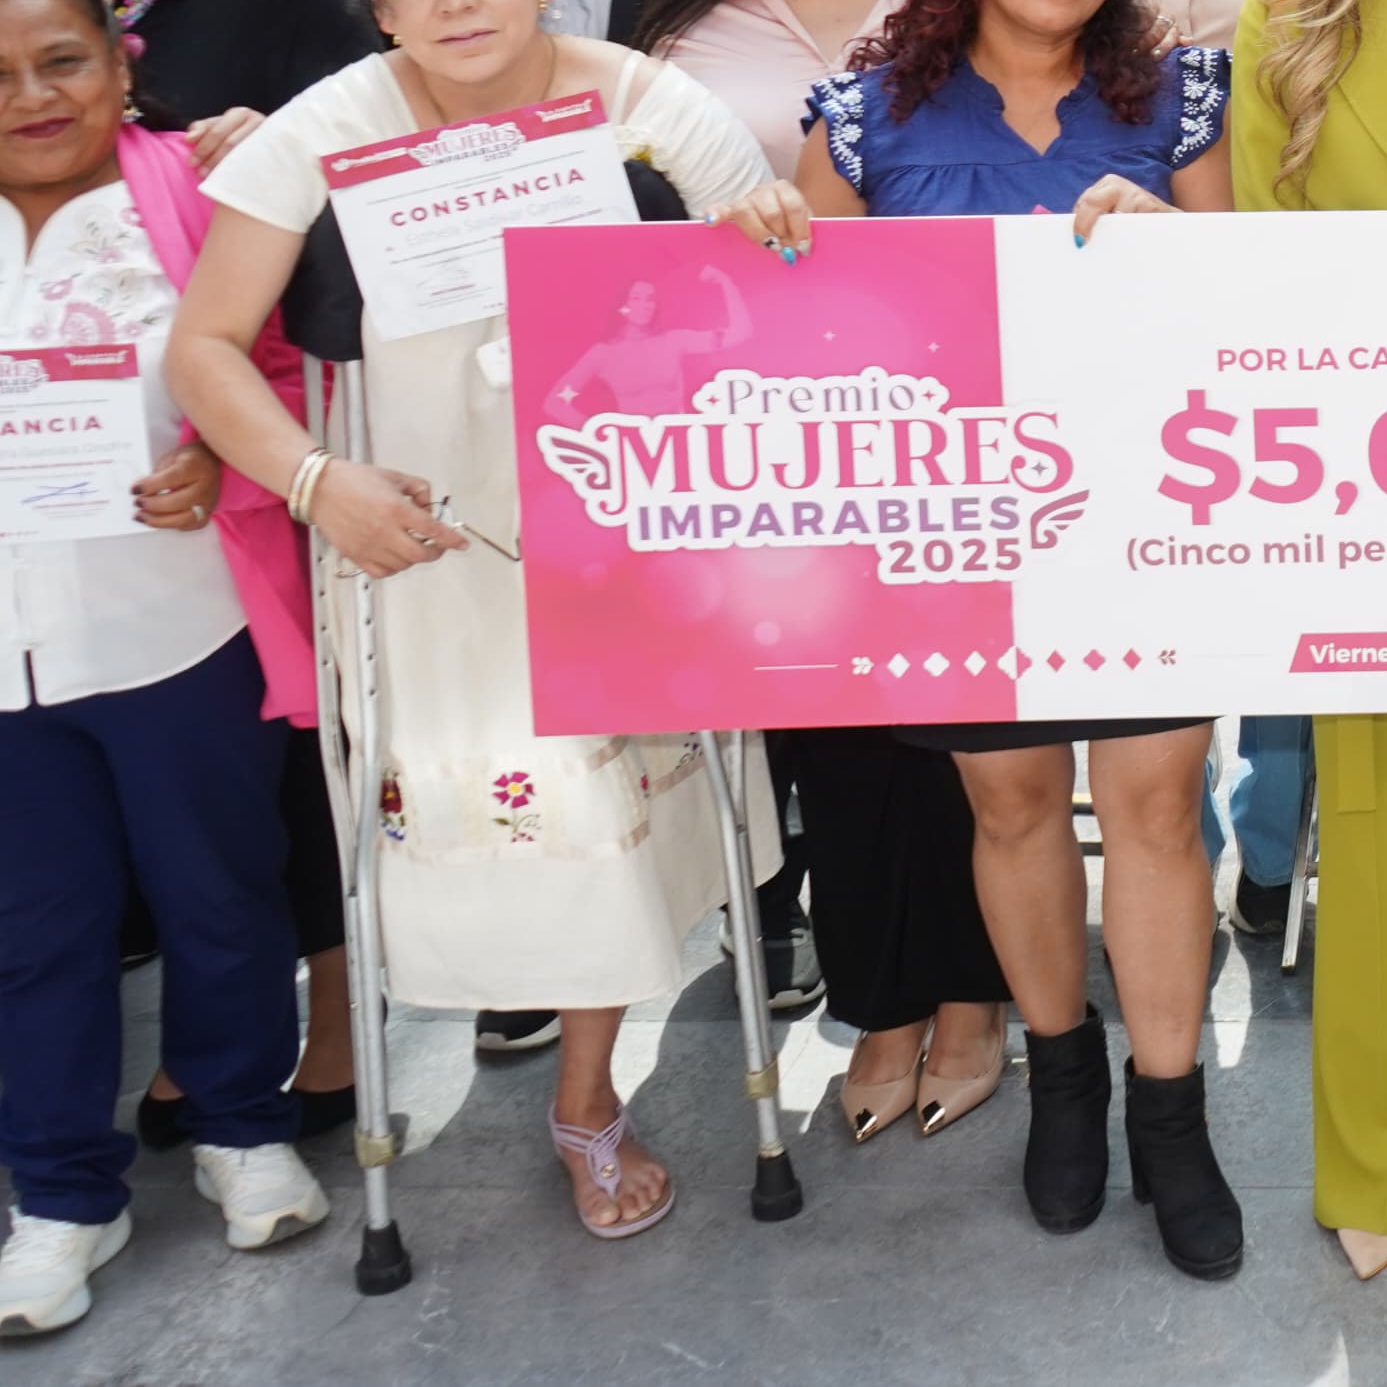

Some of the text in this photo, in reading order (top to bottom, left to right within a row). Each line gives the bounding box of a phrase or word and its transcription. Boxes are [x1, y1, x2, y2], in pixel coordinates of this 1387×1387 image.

[390, 167, 585, 228] CONSTANCIA
[1216, 347, 1288, 373] POR
[1298, 347, 1341, 371] LA
[727, 376, 916, 415] Premio
[0, 415, 103, 436] ANCIA
[598, 411, 1075, 515] MUJERES
[638, 495, 1022, 541] IMPARABLES
[889, 537, 1023, 574] 2025
[1126, 535, 1252, 571] (Cinco
[1262, 533, 1326, 565] mil
